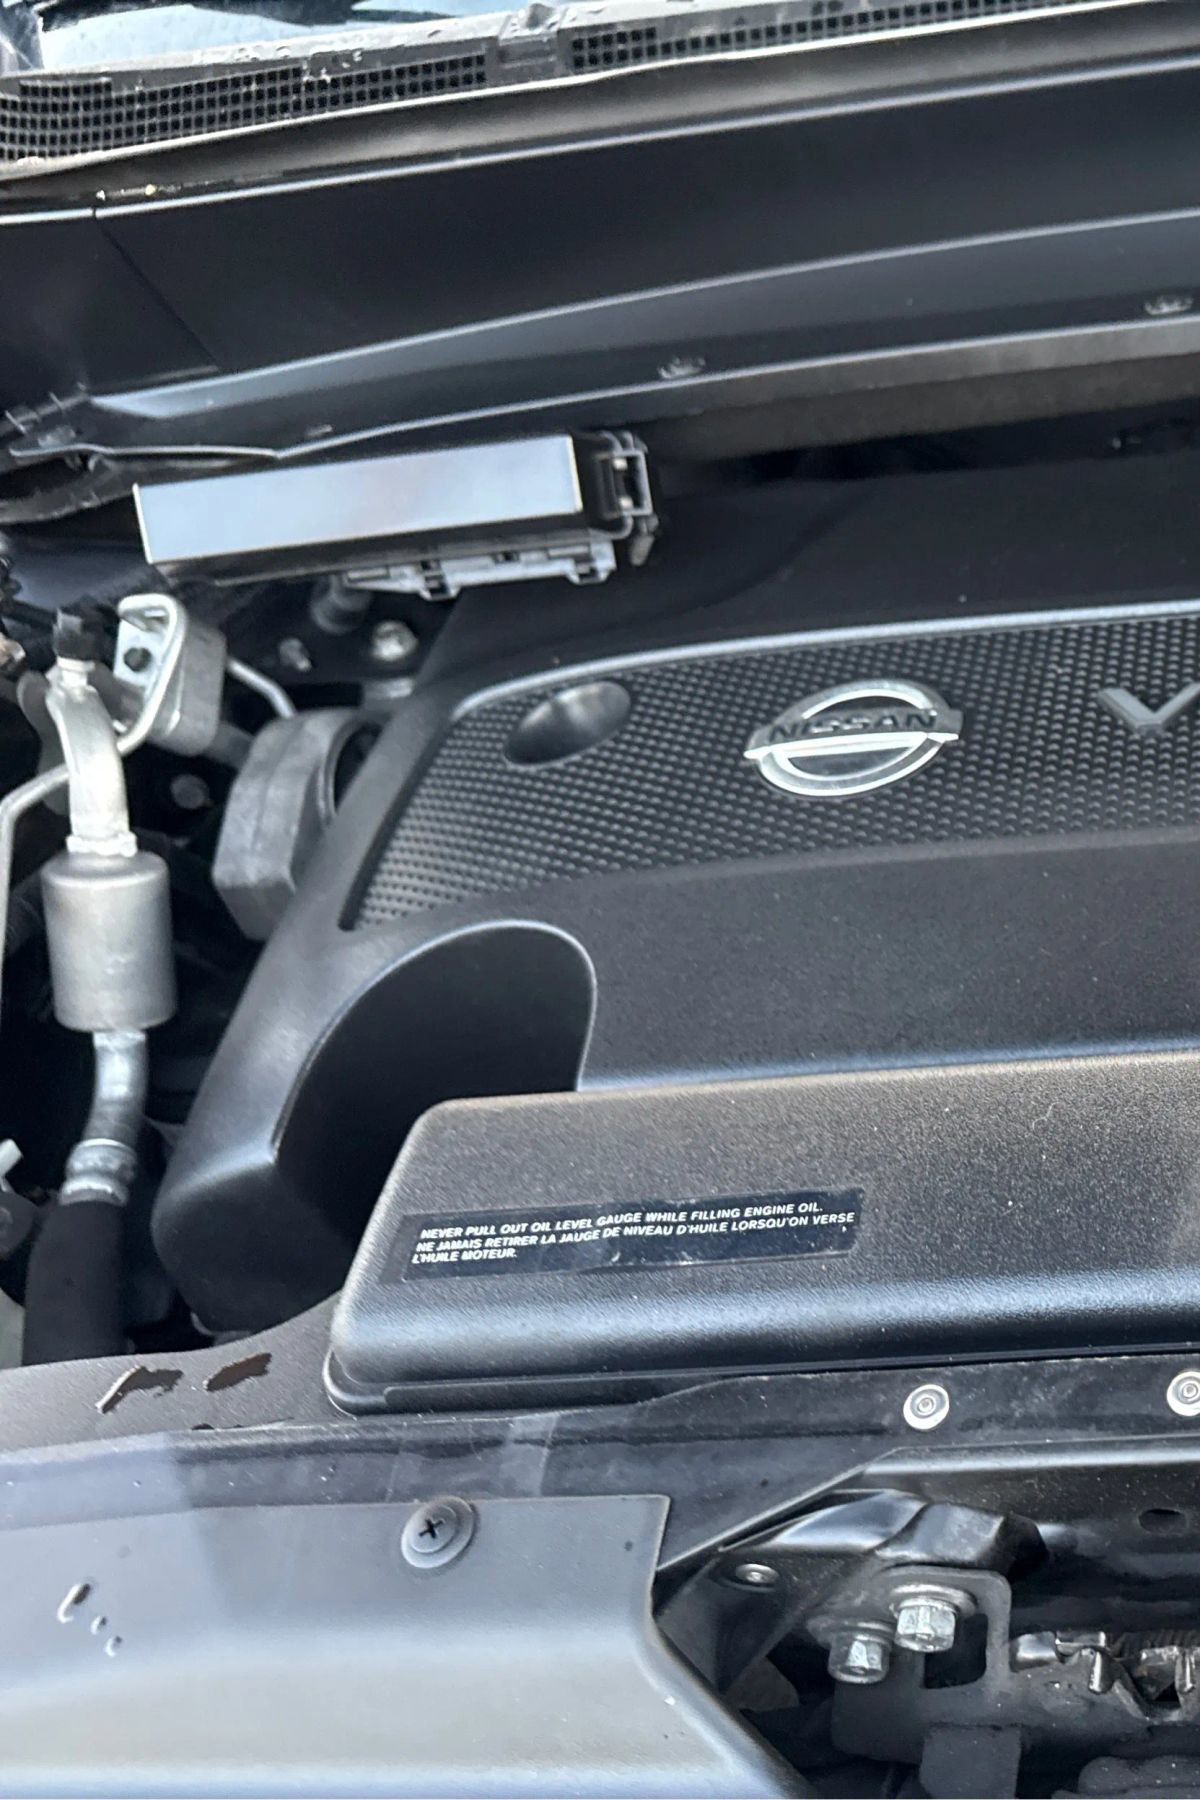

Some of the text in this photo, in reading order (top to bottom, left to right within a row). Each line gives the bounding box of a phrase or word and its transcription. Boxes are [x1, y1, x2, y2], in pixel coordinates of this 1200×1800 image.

[768, 712, 938, 744] NISSAN
[416, 1212, 855, 1252] NE JAMAIS RETIRER LA JAUGE DE NIVEAU D'HUILE LORSQU'ON VERSE
[420, 1202, 823, 1239] NEVER PULL OUT OIL LEVEL GAUGE WHILE FILLING ENGINE OIL.
[412, 1248, 517, 1264] L'HUILE MOTEUR.
